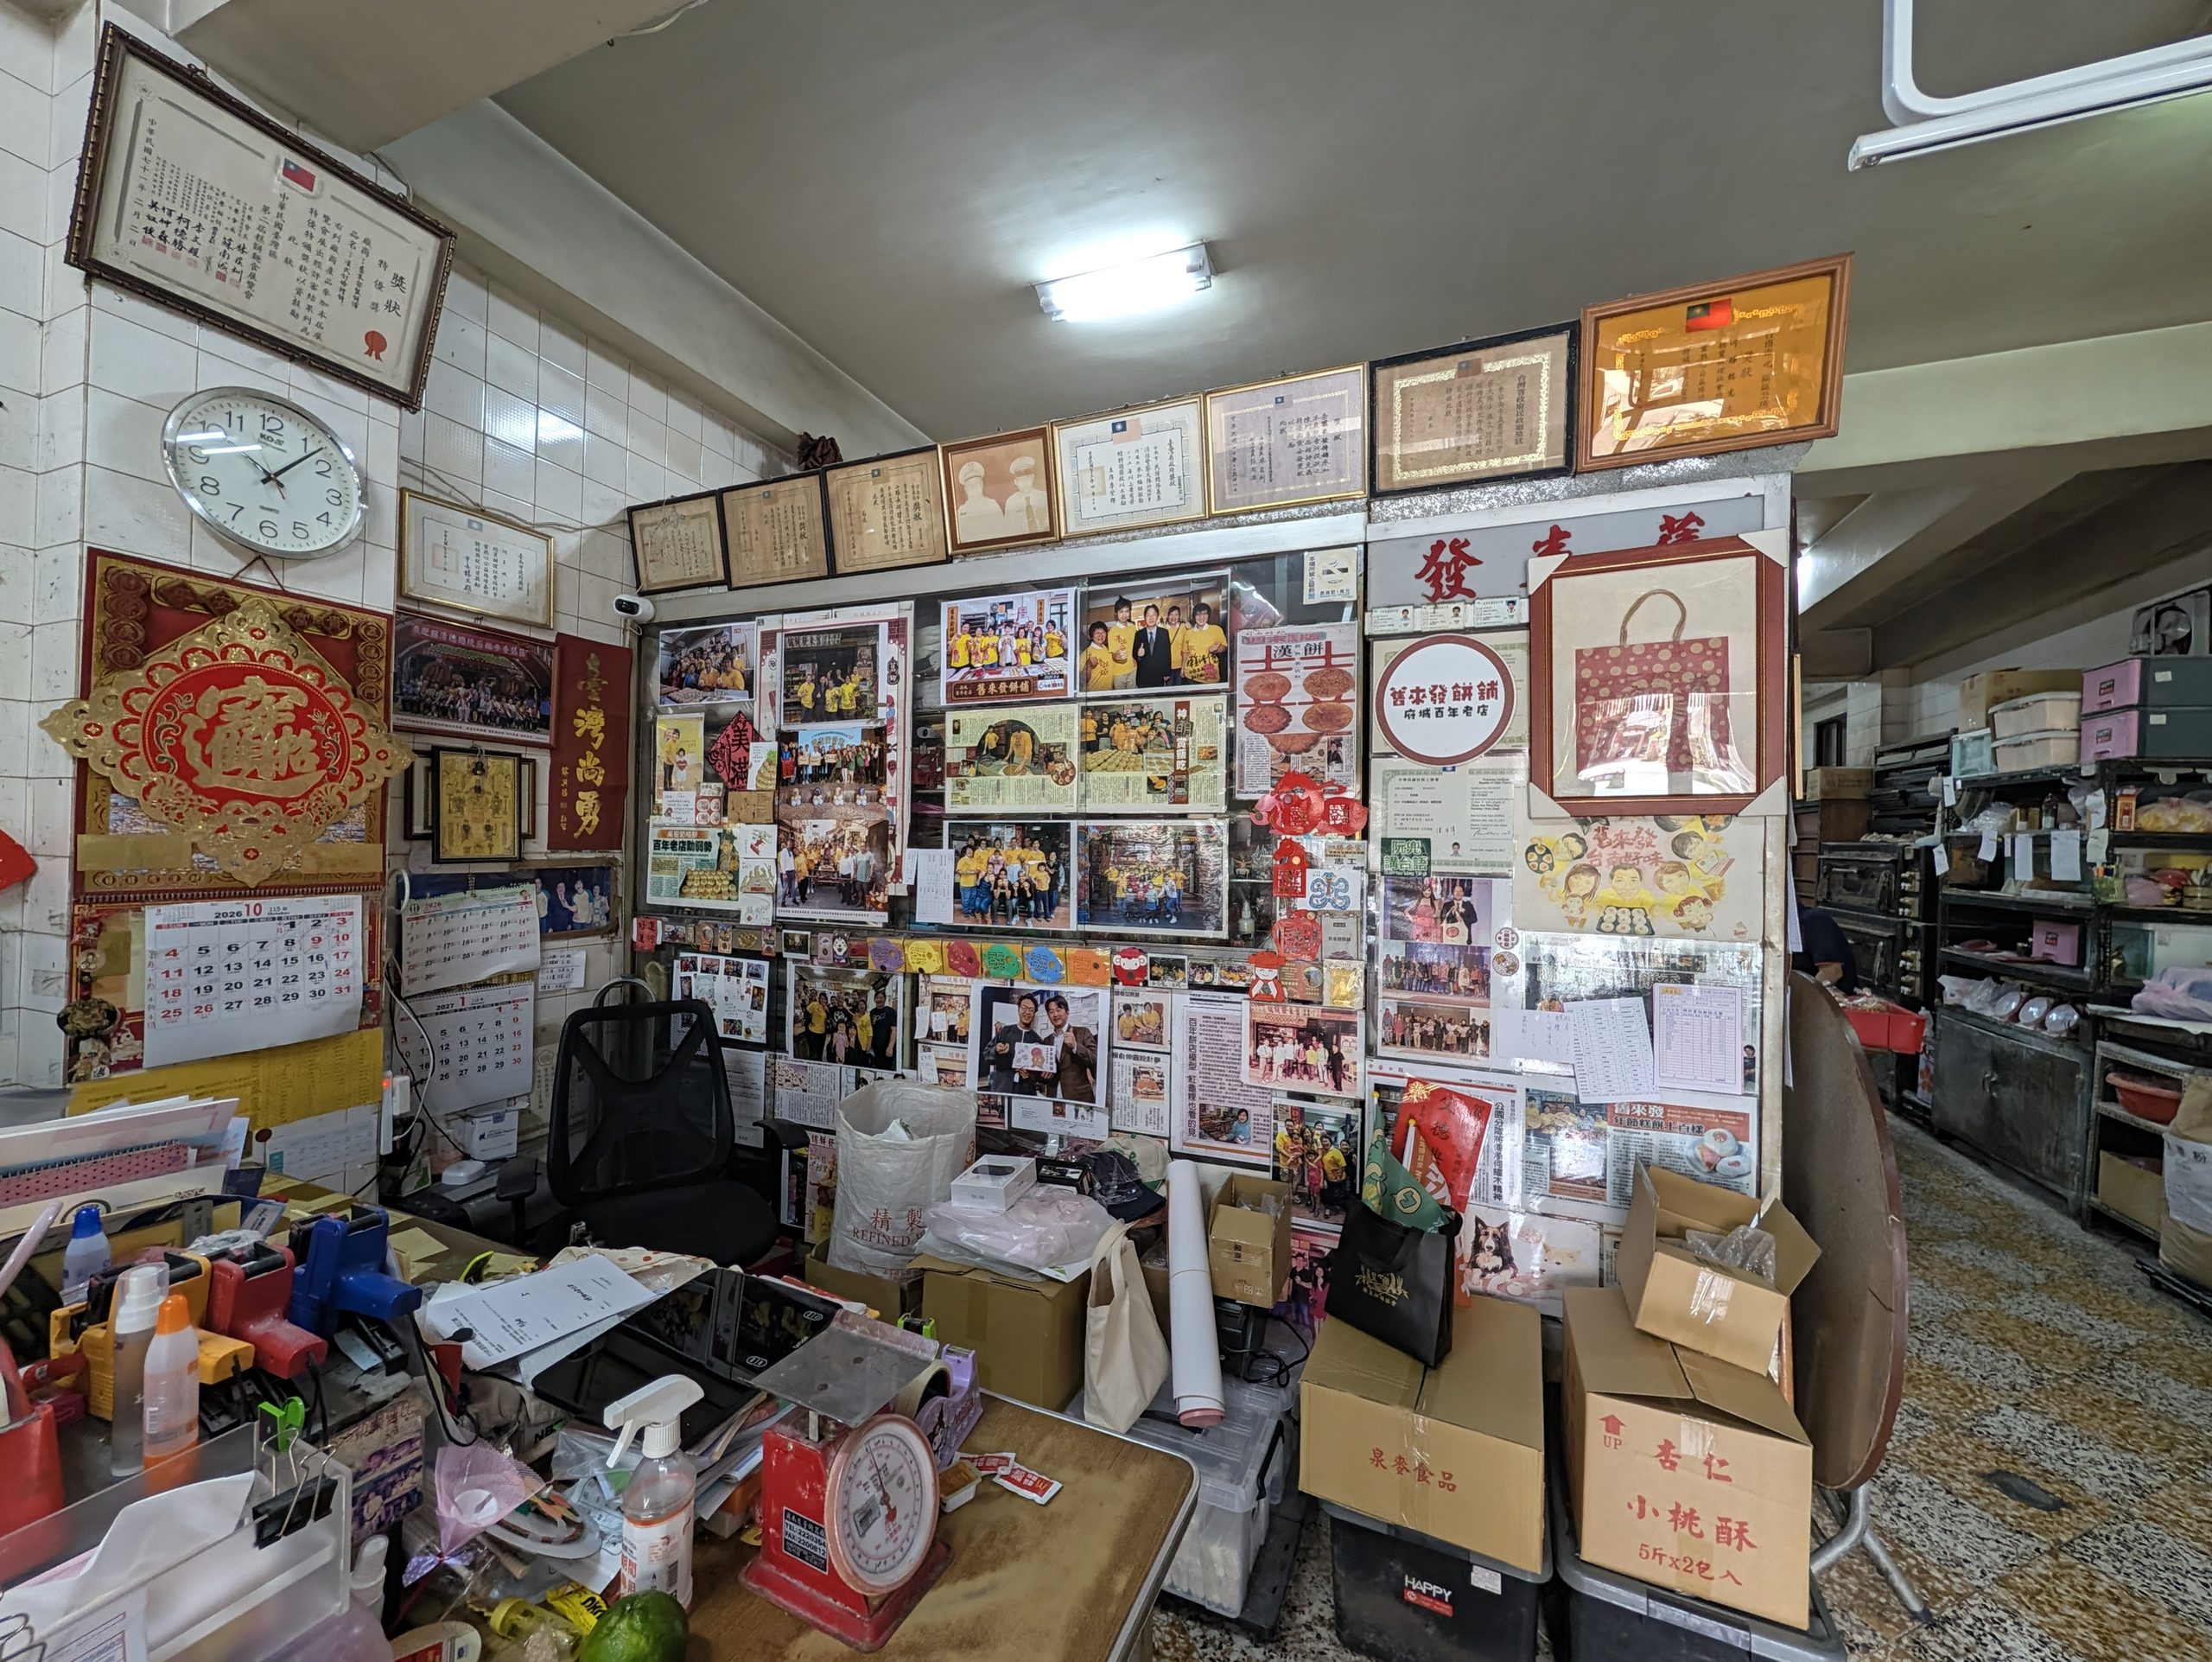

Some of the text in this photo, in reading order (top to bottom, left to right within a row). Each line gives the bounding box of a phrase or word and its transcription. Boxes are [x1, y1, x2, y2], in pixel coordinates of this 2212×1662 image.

[384, 272, 407, 318] 獎狀
[225, 410, 244, 432] 11
[259, 413, 284, 437] 12
[188, 444, 210, 465] 9
[301, 437, 308, 453] 1
[315, 459, 332, 479] 2
[200, 475, 220, 497] 8
[326, 488, 343, 506] 3
[226, 501, 245, 521] 7
[315, 511, 333, 528] 4
[259, 519, 278, 538] 6
[291, 521, 309, 539] 5
[1403, 703, 1491, 721] 府城百年老店
[652, 839, 713, 853] 百年老店助弱勢
[214, 902, 263, 920] 2026 10
[283, 920, 296, 929] 1
[311, 919, 322, 927] 2
[164, 933, 350, 958] 4 5 6 7 8 9 10
[161, 951, 351, 978] 11 12 13 14 15 16 17
[161, 968, 351, 999] 18 19 20 21 22 23 24
[161, 985, 352, 1019] 25 26 27 28 29 30 31
[435, 996, 467, 1011] 2027 1
[1188, 1017, 1198, 1071] 百年餅店模型
[418, 1062, 430, 1071] 18
[439, 1058, 450, 1067] 19
[439, 1073, 450, 1081] 26
[458, 1068, 469, 1077] 27
[494, 1060, 505, 1069] 29
[870, 1207, 925, 1232] 精製
[852, 1227, 912, 1248] REFINED
[1602, 1433, 1623, 1450] UP
[1652, 1438, 1733, 1484] 杏仁
[1625, 1493, 1758, 1552] 小桃酥
[1404, 1573, 1452, 1603] HAPPY
